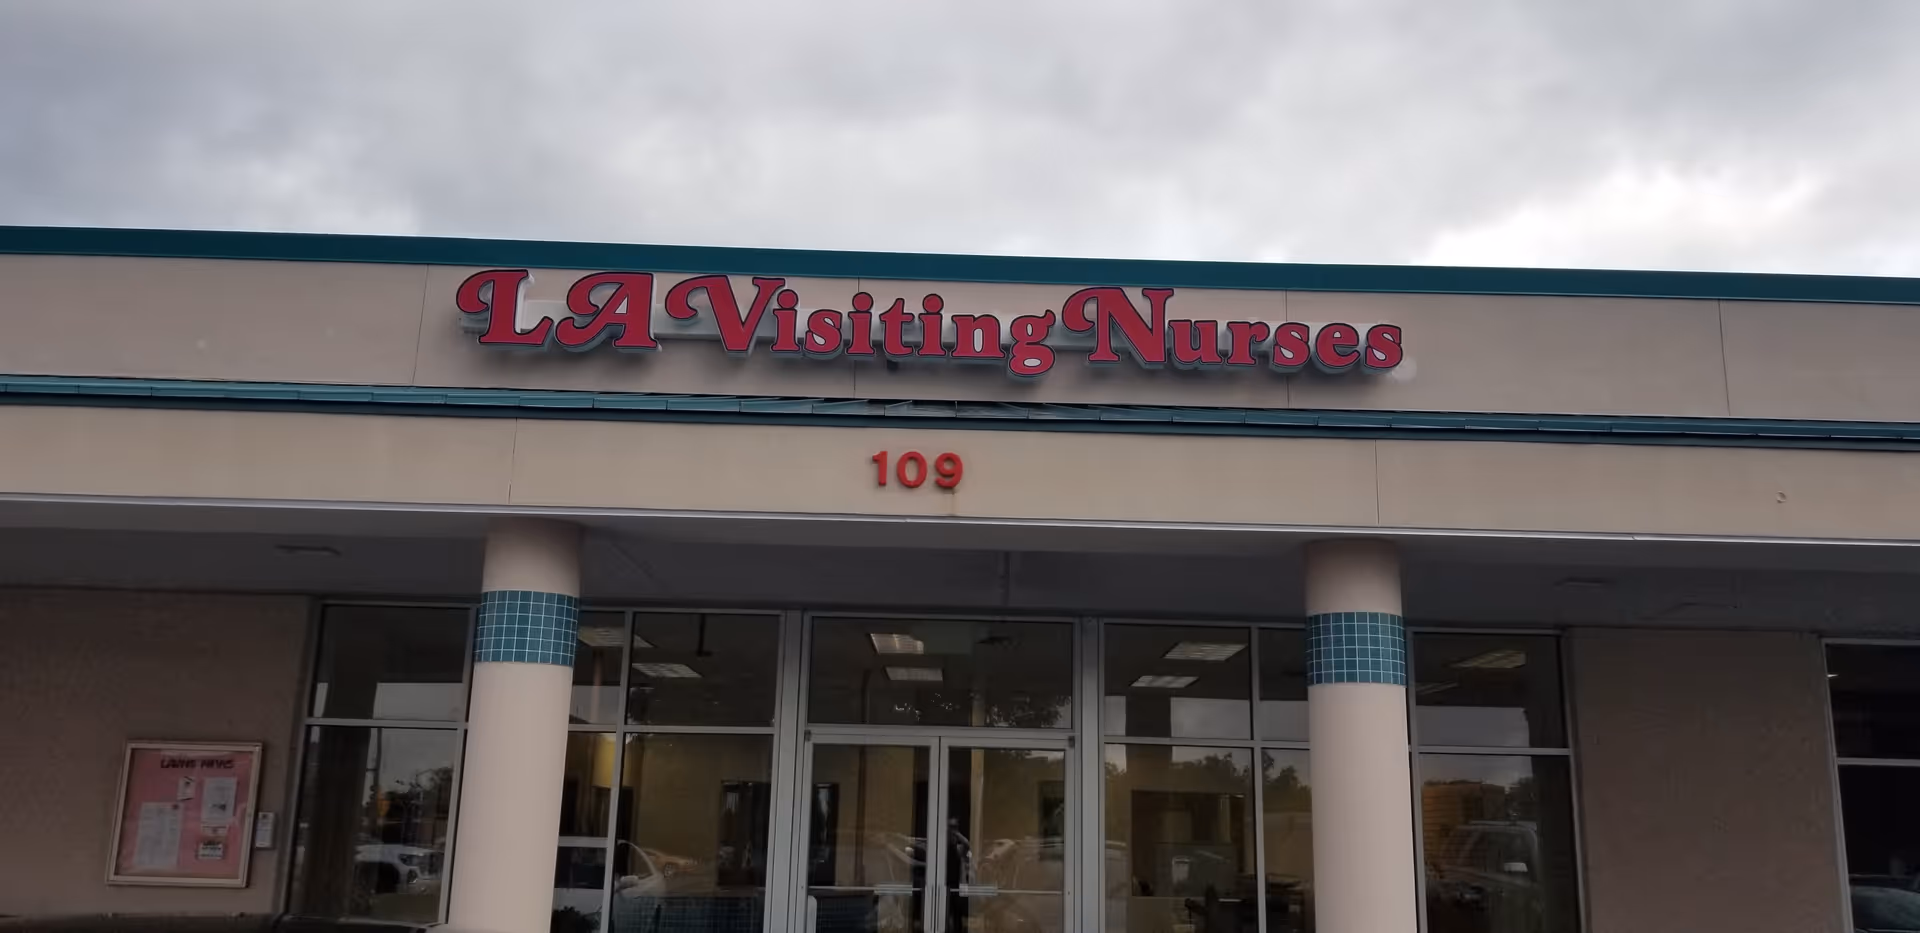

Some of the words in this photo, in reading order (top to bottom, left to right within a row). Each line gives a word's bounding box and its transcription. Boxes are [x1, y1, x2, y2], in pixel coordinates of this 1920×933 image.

[456, 269, 658, 349] LA
[664, 275, 1056, 376] Visiting
[1062, 287, 1403, 368] Nurses
[871, 450, 964, 488] 109
